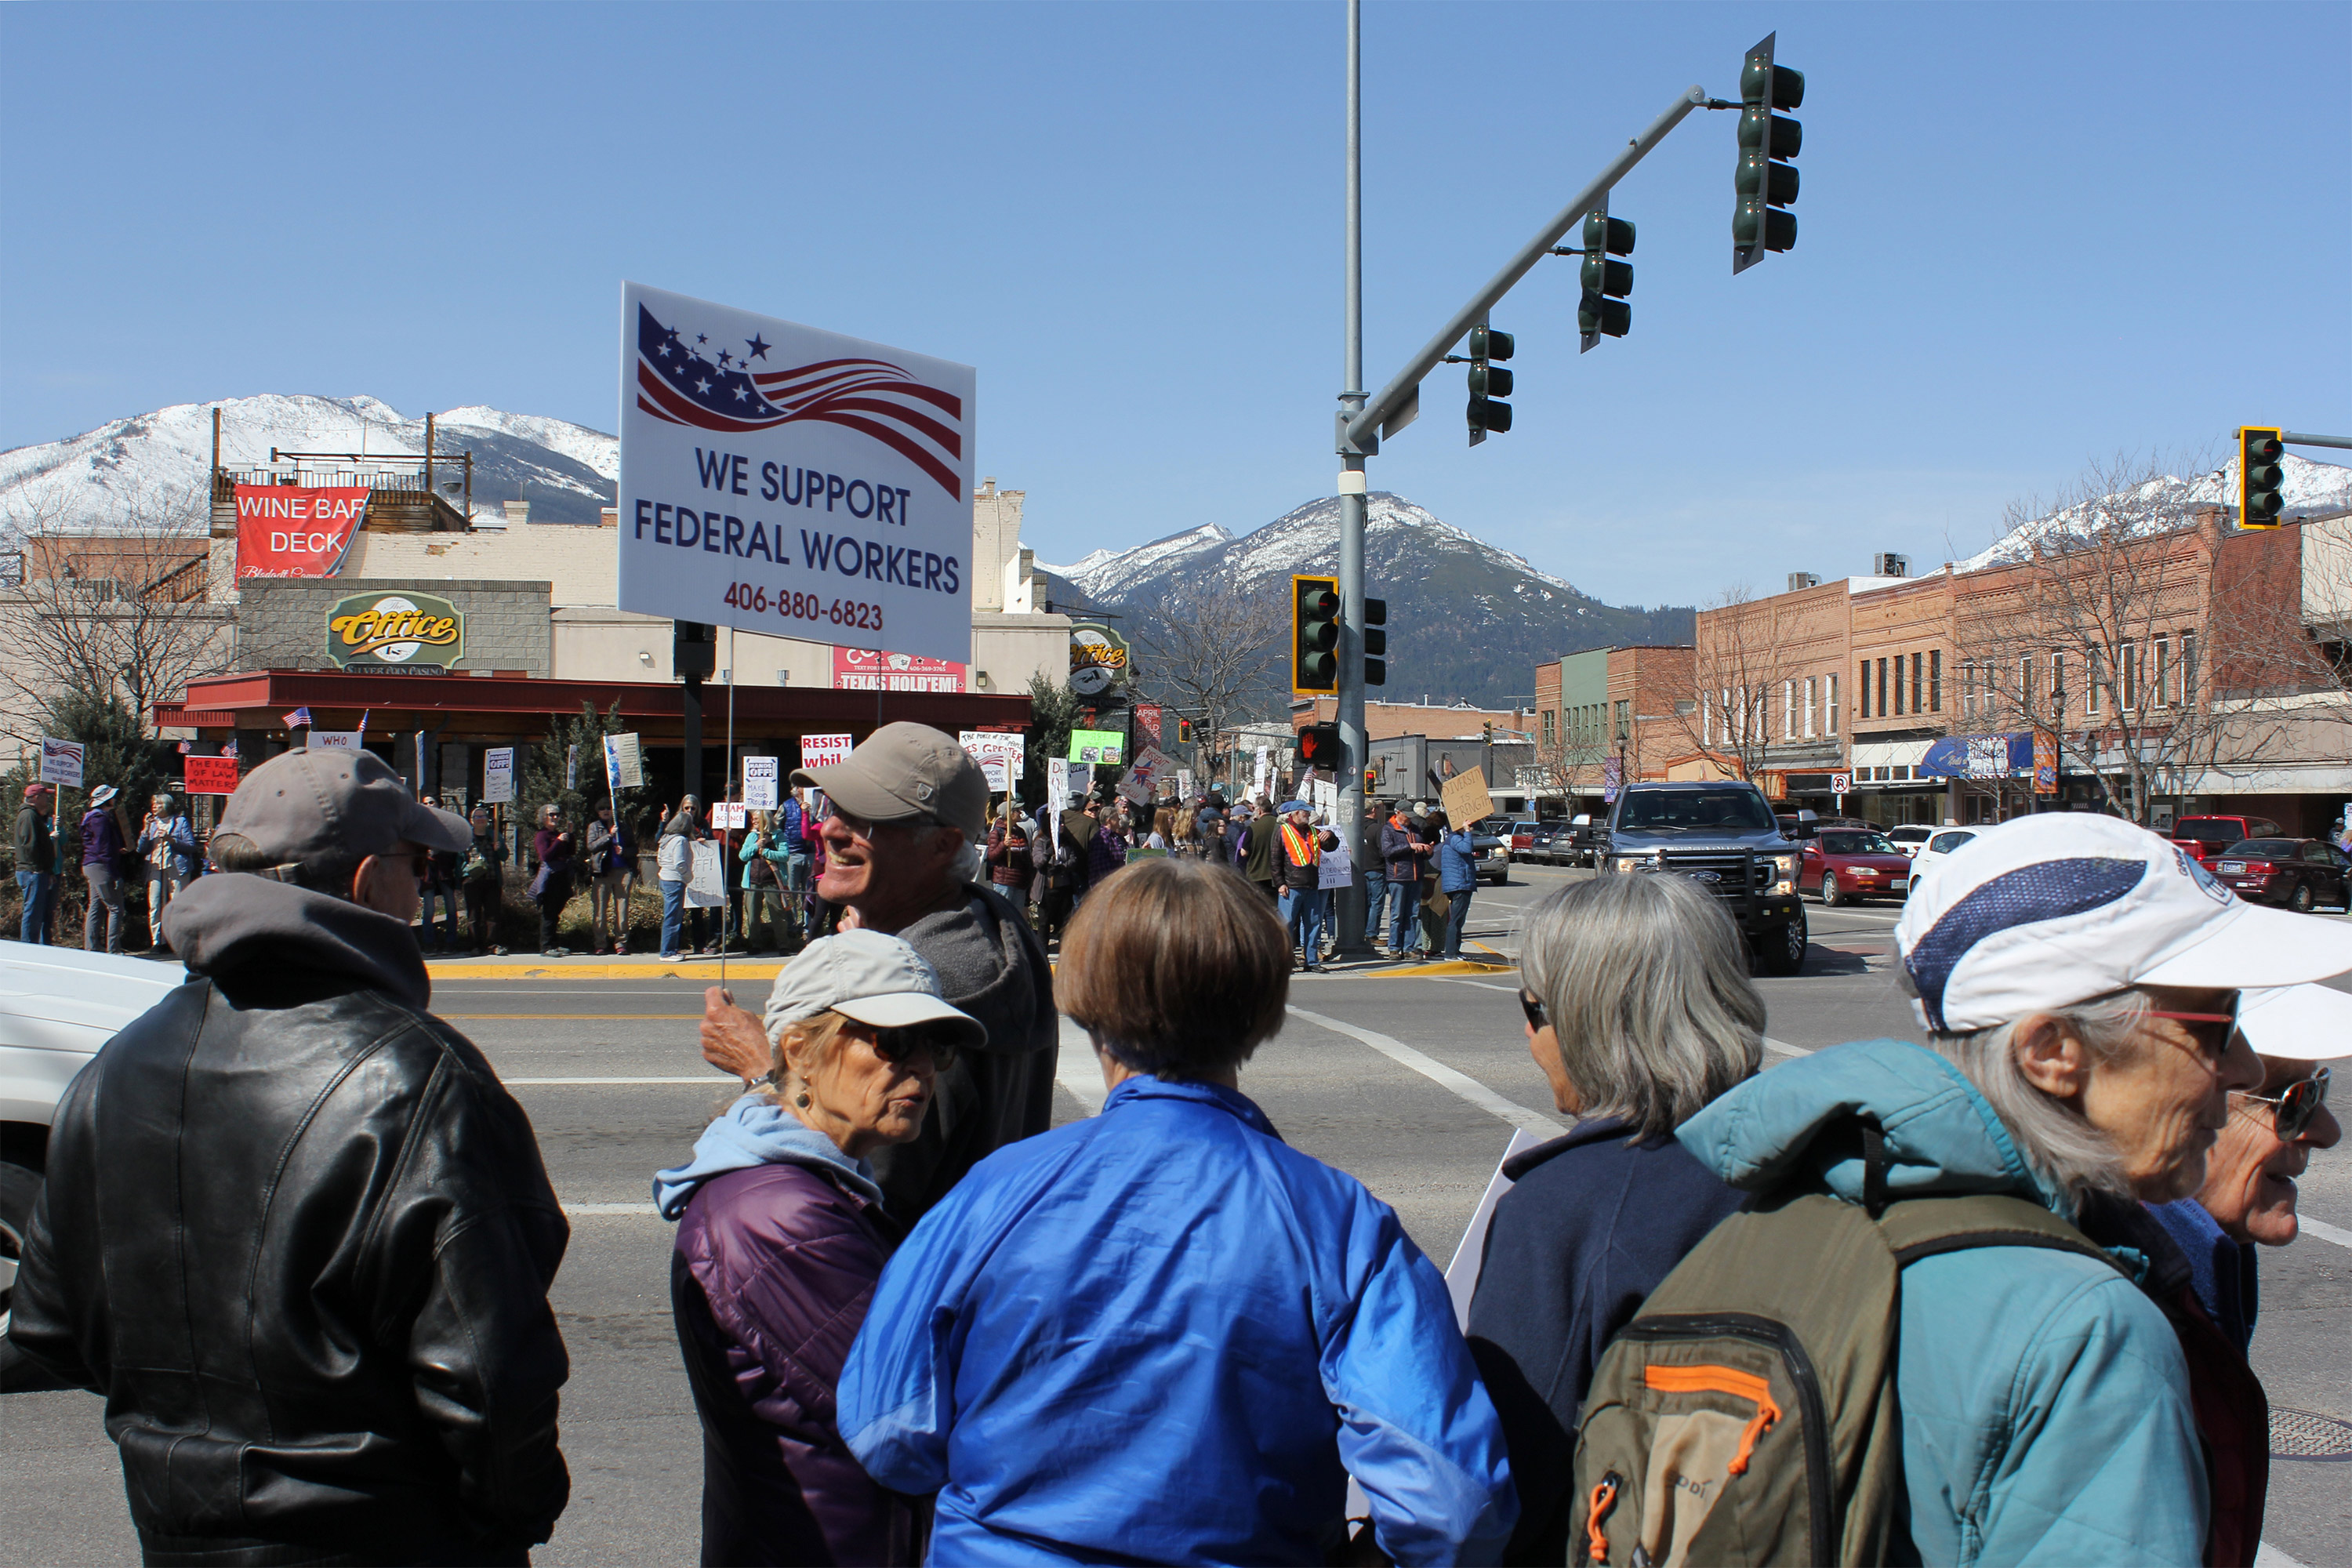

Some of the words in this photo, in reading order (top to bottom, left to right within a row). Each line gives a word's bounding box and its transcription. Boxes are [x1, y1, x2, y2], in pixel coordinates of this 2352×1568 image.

[695, 447, 749, 496] WE
[760, 461, 911, 526] SUPPORT
[238, 496, 307, 519] WINE
[315, 498, 367, 519] BAR
[270, 532, 343, 553] DECK
[635, 499, 790, 565] FEDERAL
[800, 528, 960, 594] WORKERS
[724, 582, 883, 631] 406-880-6823
[330, 609, 459, 646] Office
[408, 666, 443, 676] CASINO
[840, 675, 887, 691] TEXAS
[889, 676, 958, 692] HOLD'EM!
[1137, 709, 1160, 717] APRIL
[322, 735, 347, 746] WHO
[803, 737, 851, 748] RESIST
[962, 734, 975, 742] THE
[965, 743, 978, 753] IS
[982, 743, 1023, 764] GREATER
[1142, 748, 1171, 768] DISSENT
[189, 759, 210, 768] THE
[215, 760, 236, 769] RULE
[490, 760, 510, 768] OFF!
[749, 768, 772, 777] OFF!
[189, 779, 236, 790] MATTERS
[1442, 768, 1483, 798] DIVERSITY
[747, 798, 774, 807] TROUBLE
[1460, 792, 1470, 803] IS
[1448, 795, 1491, 823] STRENGTH
